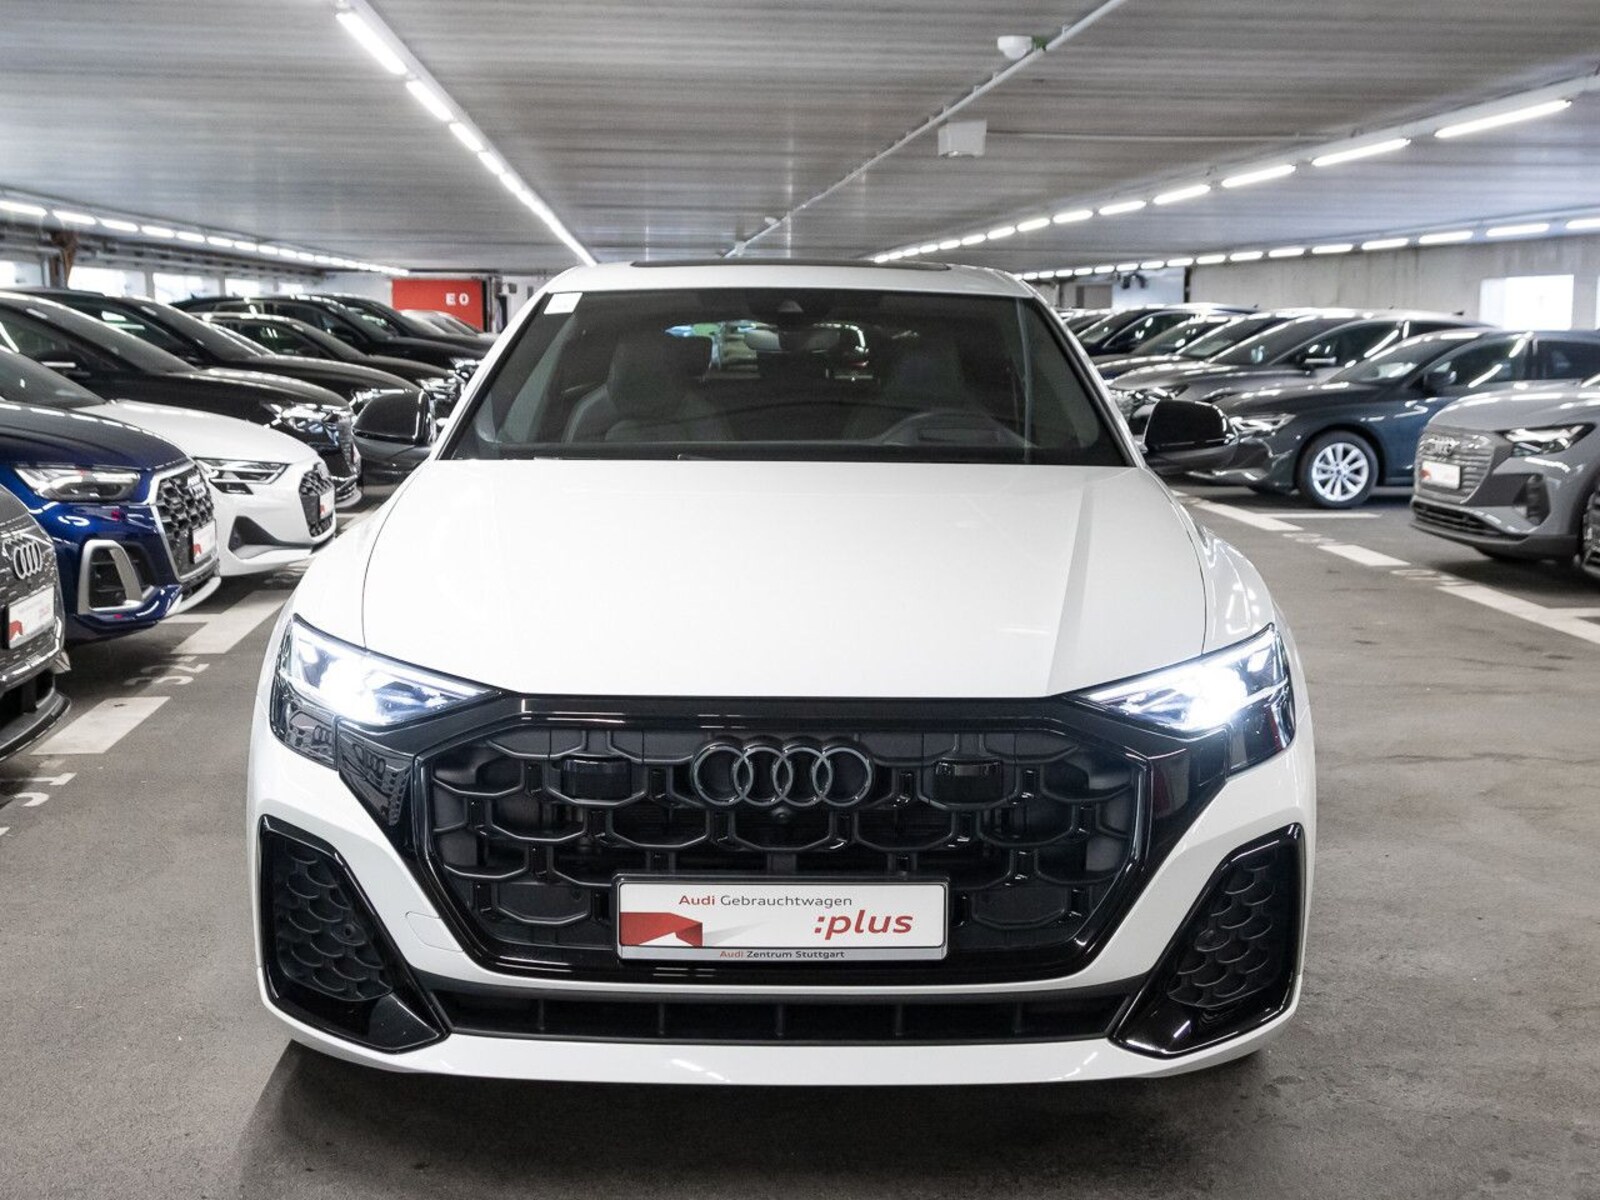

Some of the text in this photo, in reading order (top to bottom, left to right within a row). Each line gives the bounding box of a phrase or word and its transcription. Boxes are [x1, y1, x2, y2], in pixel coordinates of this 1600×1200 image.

[678, 895, 852, 909] Audi Gebrauchtwagen
[813, 909, 914, 941] :plus
[719, 950, 845, 960] Audi Zentrum Stuttgart
